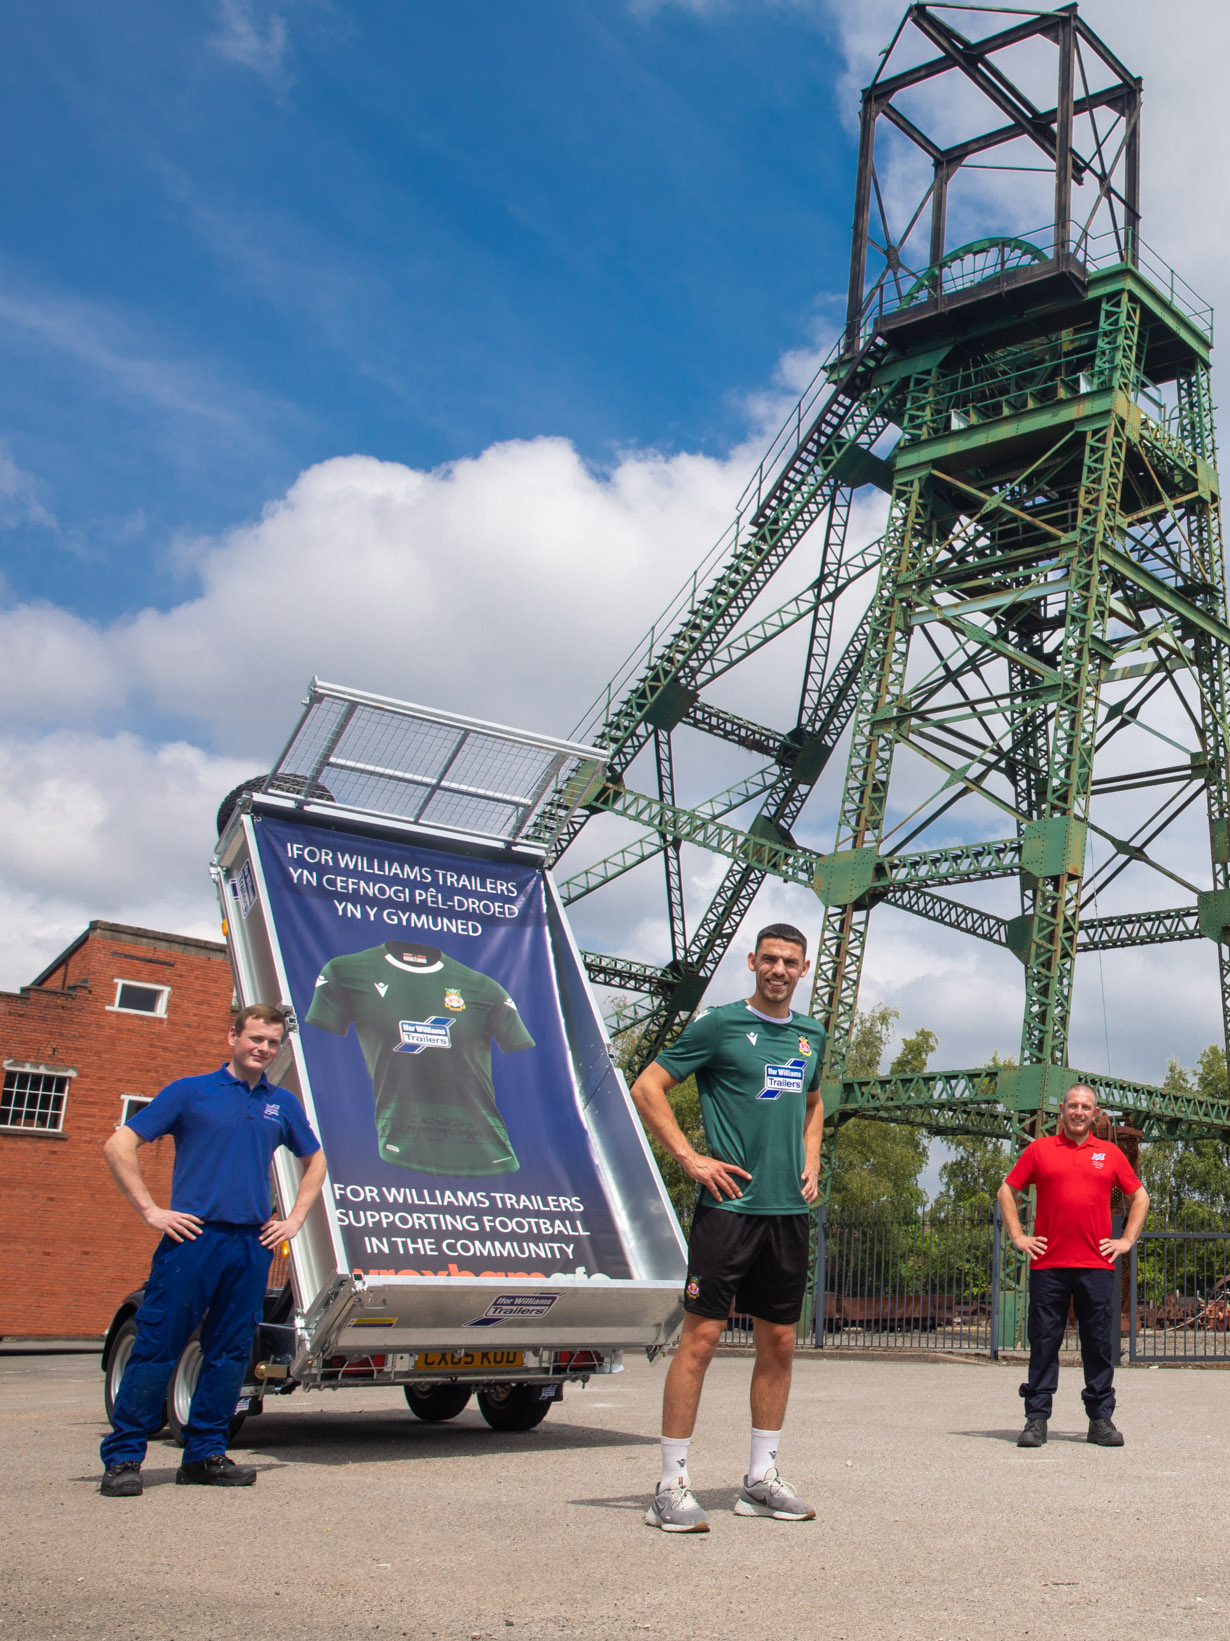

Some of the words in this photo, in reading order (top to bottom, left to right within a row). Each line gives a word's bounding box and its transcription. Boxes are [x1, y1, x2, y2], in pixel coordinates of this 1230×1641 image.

[287, 842, 333, 866] IFOR
[337, 851, 432, 882] WILLIAMS
[434, 869, 518, 897] TRAILERS
[289, 866, 317, 886] YN
[322, 874, 410, 903] CEFNOGI
[415, 888, 519, 918] PÊL-DROED
[333, 899, 361, 919] YN
[365, 905, 378, 921] Y
[383, 909, 483, 937] GYMUNED
[404, 1033, 448, 1045] Trailers
[768, 1077, 801, 1089] Trailers
[333, 1183, 380, 1203] FOR
[382, 1186, 489, 1208] WILLIAMS
[490, 1193, 584, 1212] TRAILERS
[336, 1209, 480, 1231] SUPPORTING
[483, 1216, 591, 1236] FOOTBALL
[364, 1236, 389, 1254] IN
[391, 1237, 438, 1255] THE
[442, 1239, 574, 1259] COMMUNITY
[492, 1306, 545, 1315] Trailers
[514, 1296, 553, 1305] Williams
